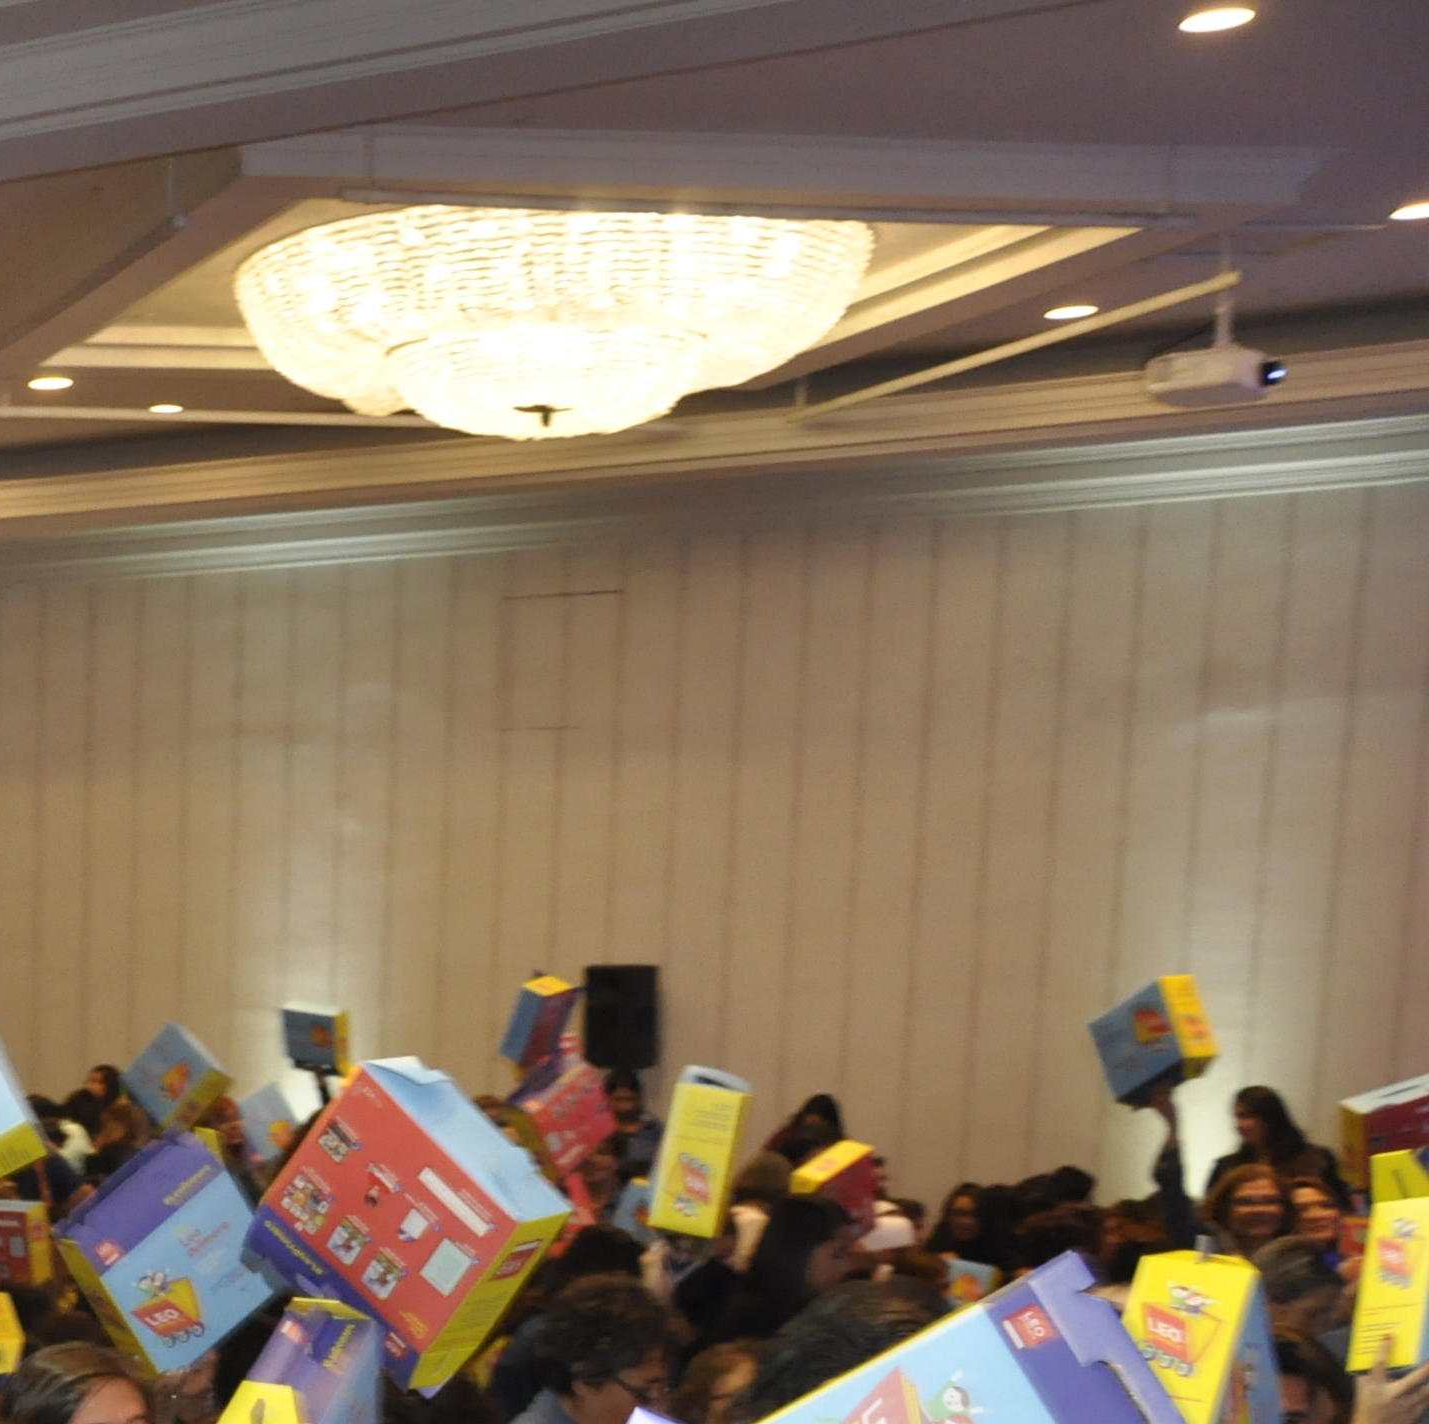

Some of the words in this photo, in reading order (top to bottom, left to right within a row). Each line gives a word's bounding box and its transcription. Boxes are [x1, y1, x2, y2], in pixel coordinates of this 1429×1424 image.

[145, 1309, 179, 1326] LEO
[1018, 1311, 1045, 1337] LEO
[1147, 1318, 1182, 1343] LEO
